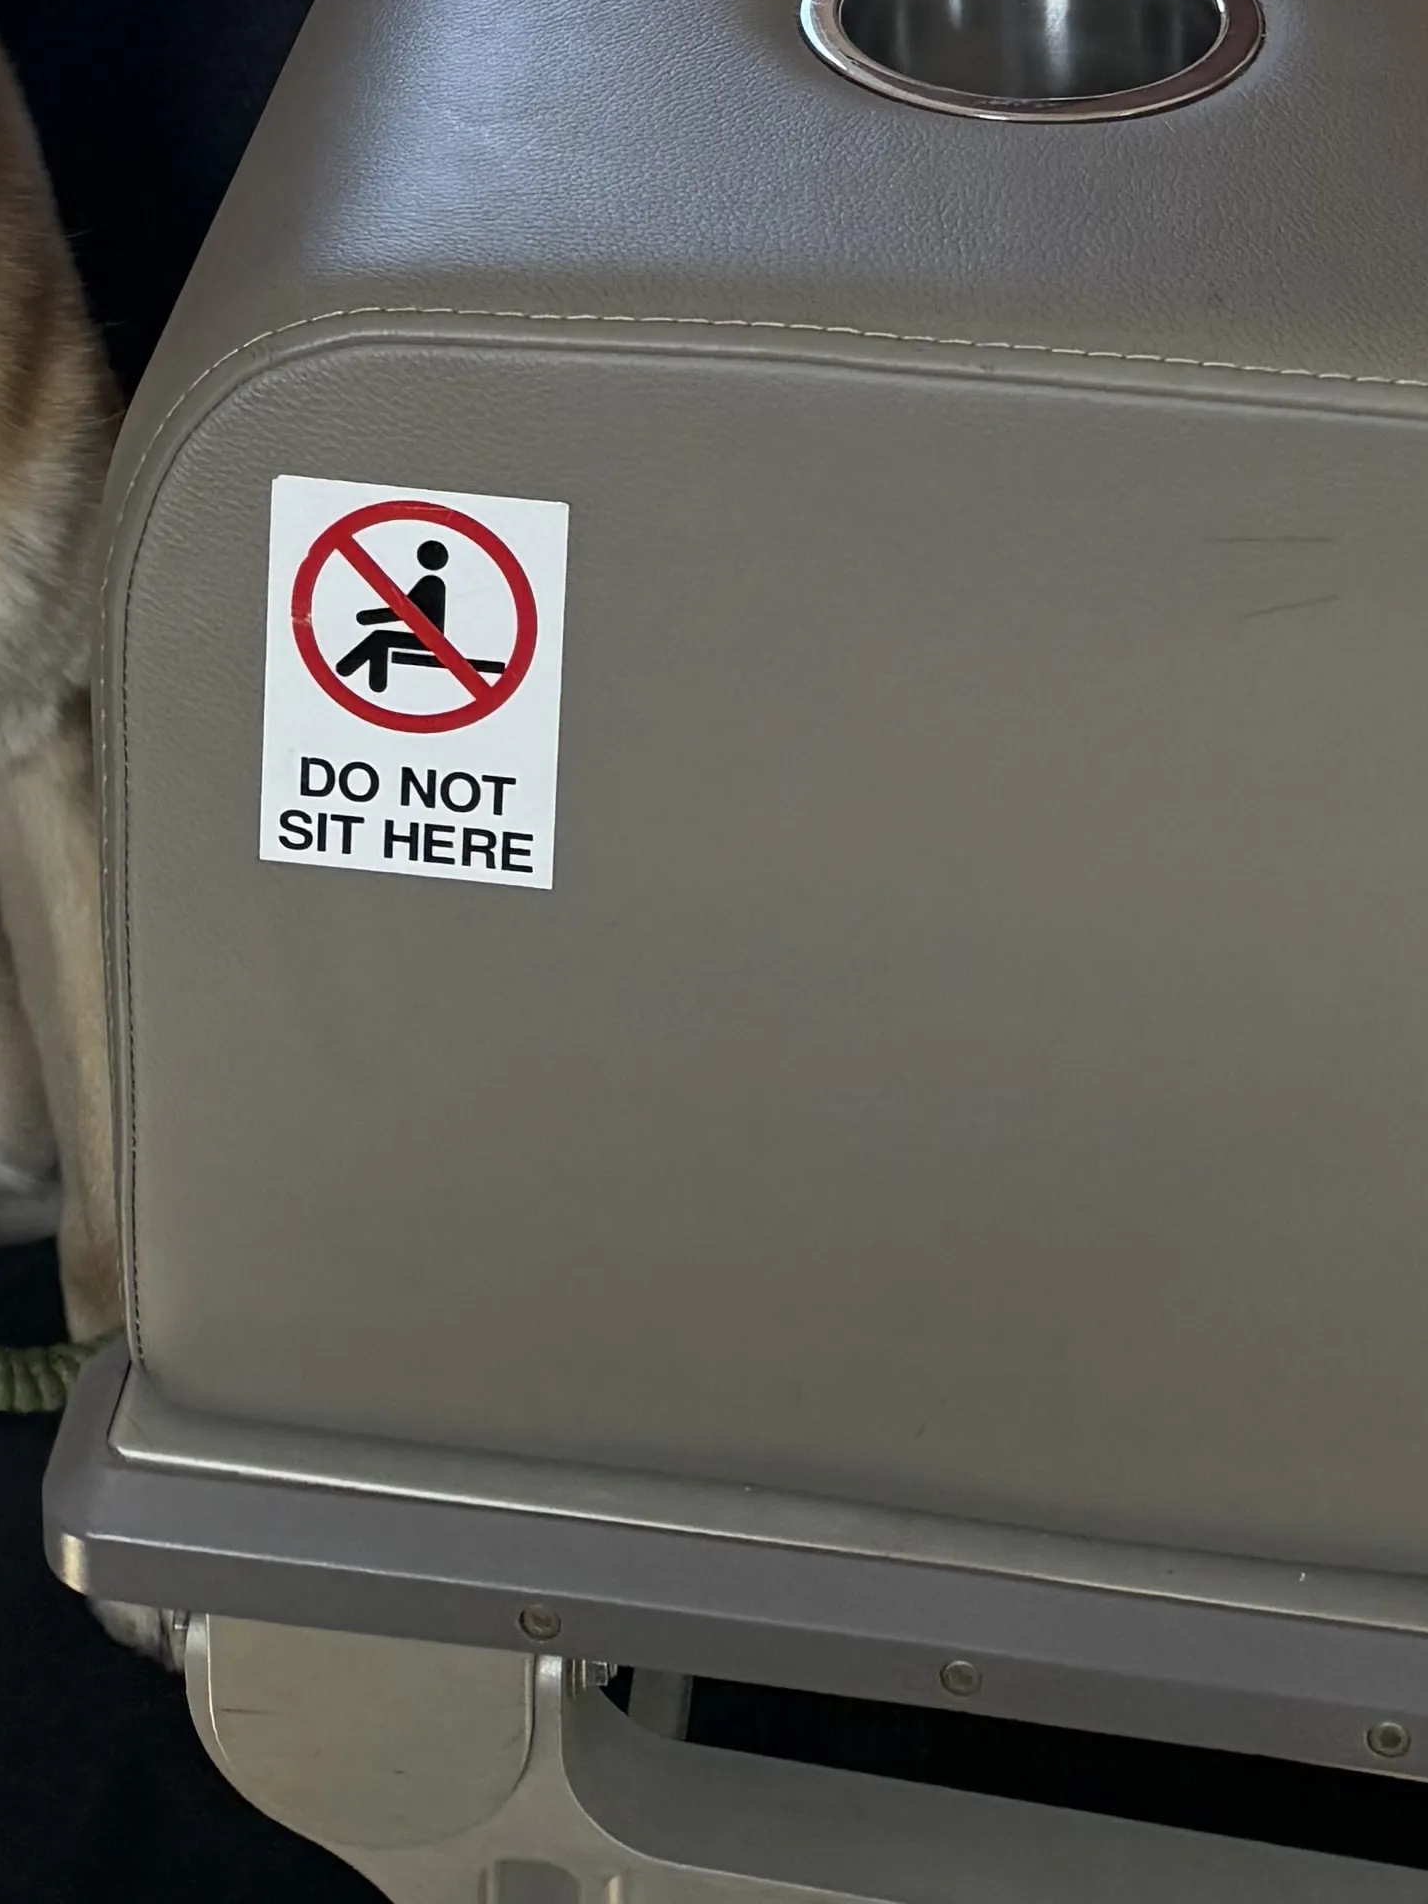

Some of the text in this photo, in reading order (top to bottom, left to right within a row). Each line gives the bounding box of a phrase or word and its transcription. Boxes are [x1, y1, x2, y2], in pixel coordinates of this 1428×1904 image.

[300, 756, 517, 816] DO NOT
[278, 809, 534, 874] SIT HERE
